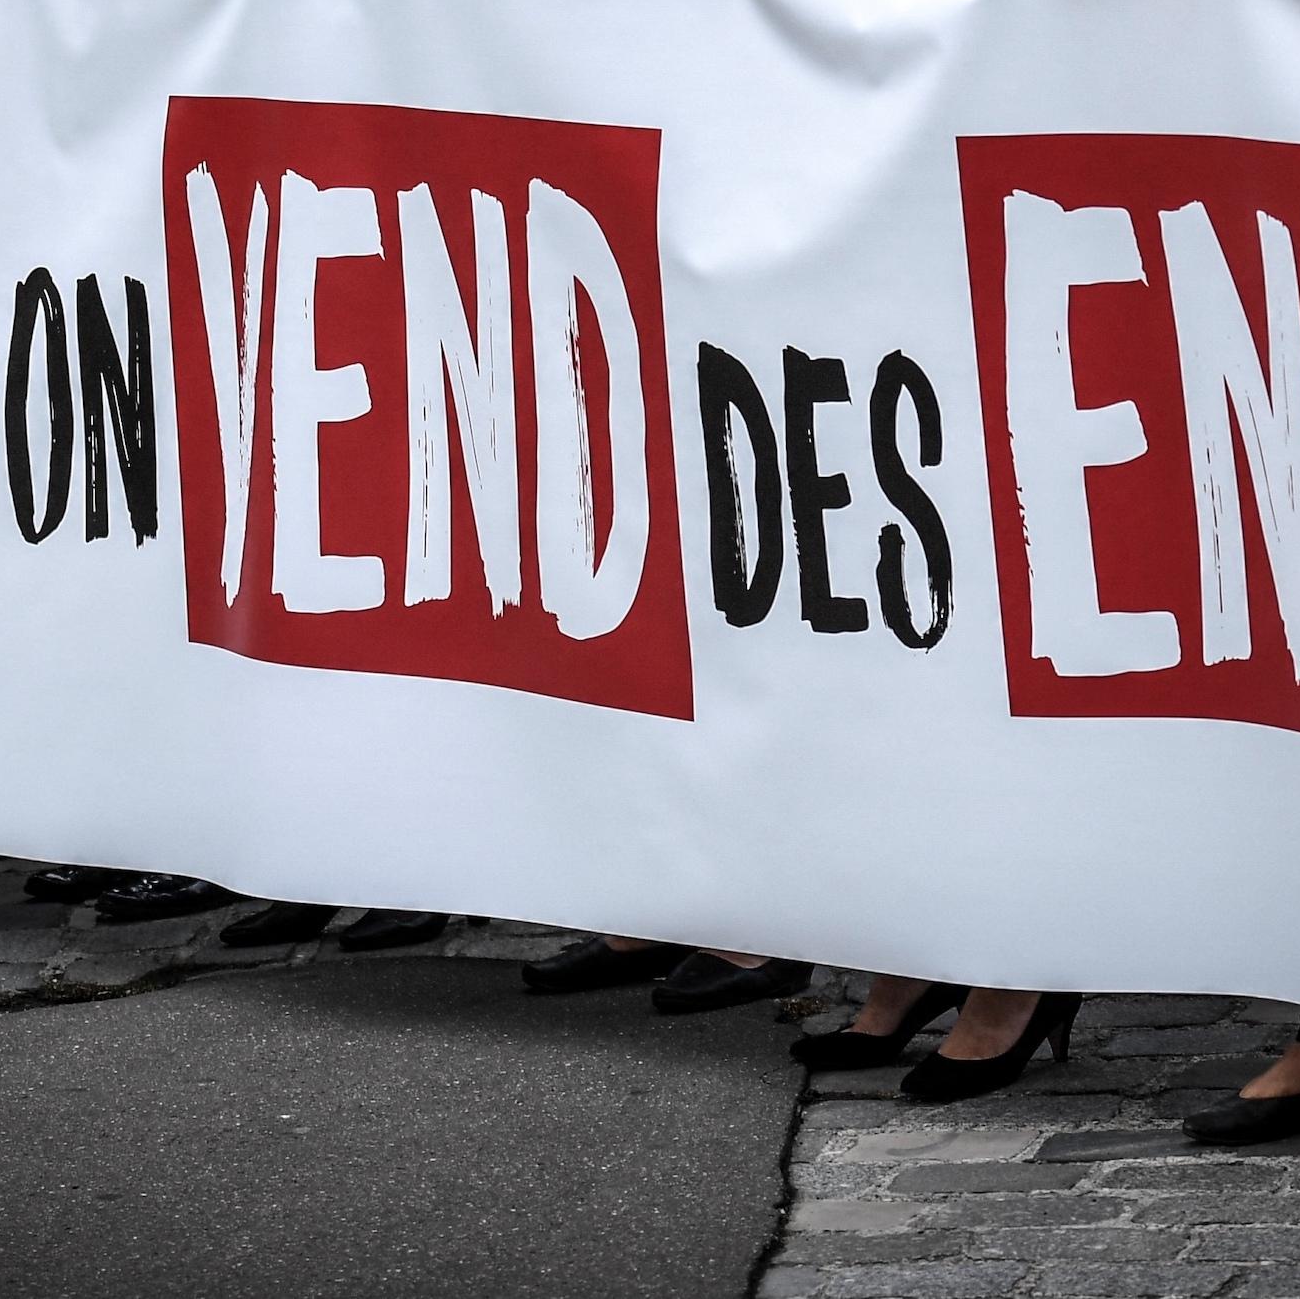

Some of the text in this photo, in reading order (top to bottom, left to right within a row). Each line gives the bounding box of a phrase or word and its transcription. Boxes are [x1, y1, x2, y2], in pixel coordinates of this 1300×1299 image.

[5, 267, 158, 547] ON
[186, 161, 651, 640] VEND
[697, 342, 953, 654] DES
